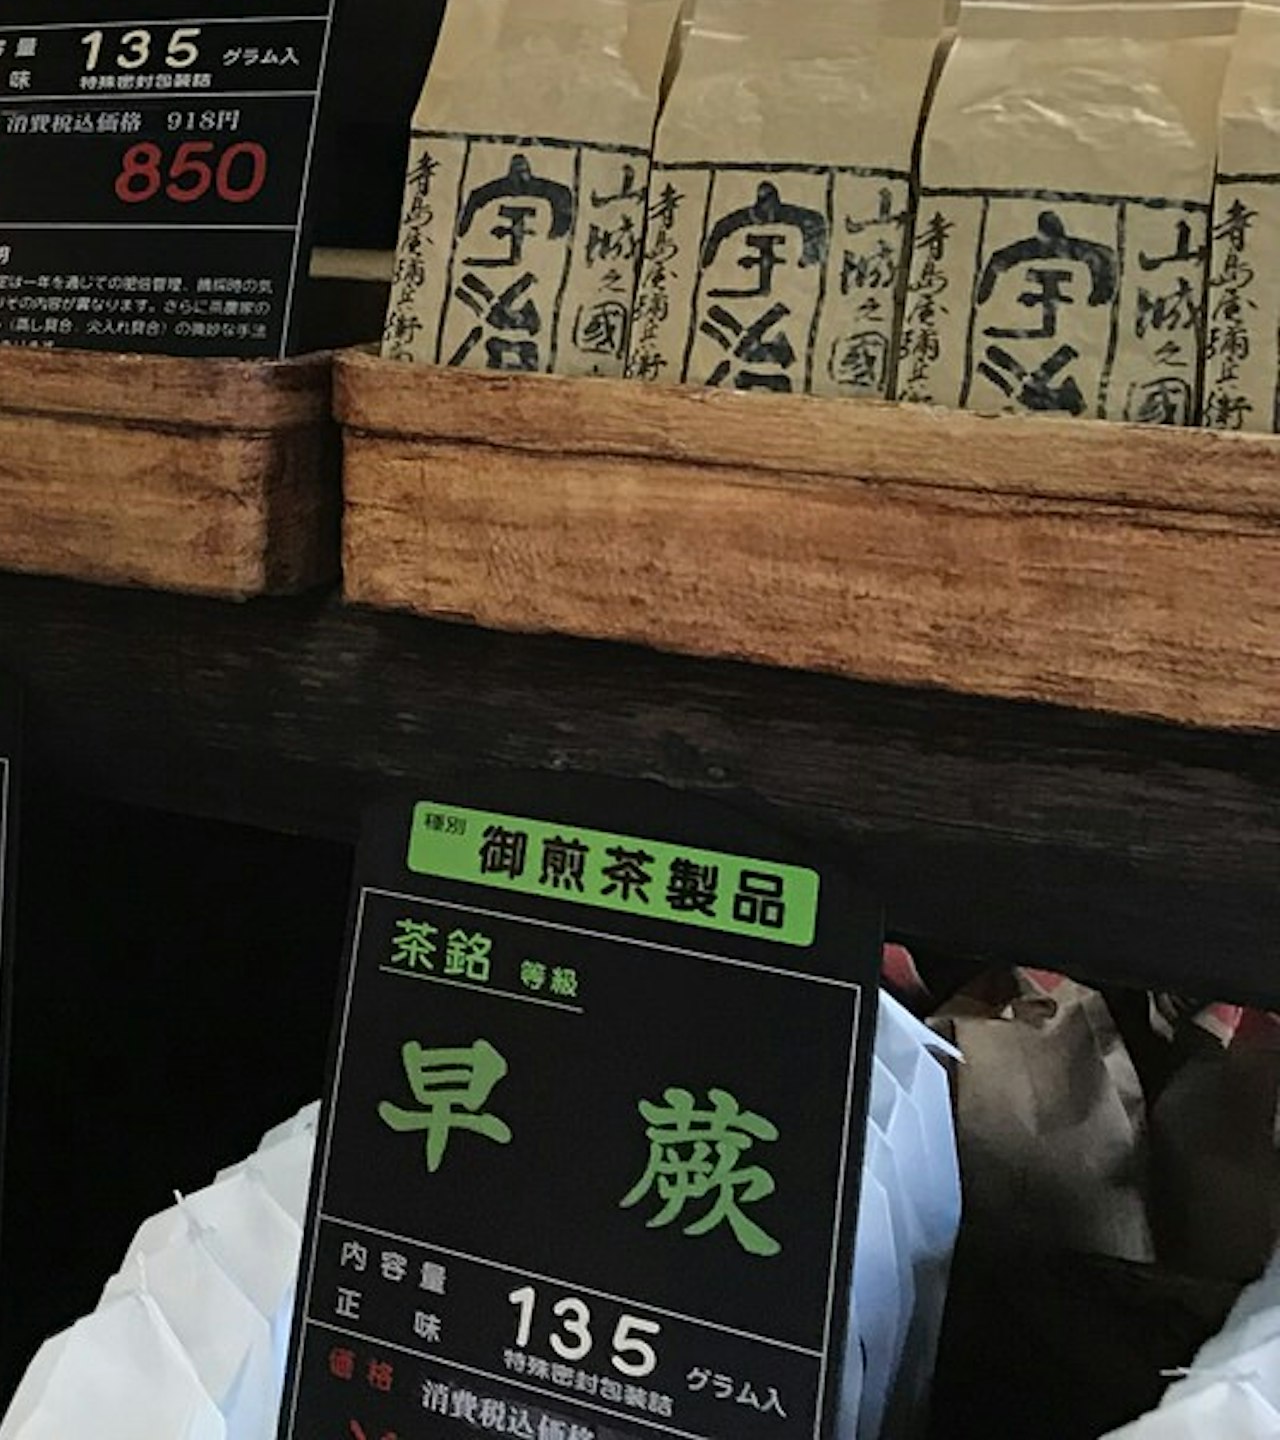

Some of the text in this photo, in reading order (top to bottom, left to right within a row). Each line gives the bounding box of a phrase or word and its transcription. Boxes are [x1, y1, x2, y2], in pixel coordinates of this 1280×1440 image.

[80, 27, 201, 70] 135
[222, 46, 300, 66] グラム入
[6, 111, 142, 135] 消費税込価格
[167, 109, 240, 132] 918円
[114, 142, 268, 204] 850
[423, 812, 788, 930] 種別 御煎茶製品
[389, 918, 580, 998] 茶銘 等級
[376, 1038, 784, 1258] 早蕨
[328, 1346, 394, 1393] 価格
[333, 1286, 675, 1417] 正味 特殊密封包装詰
[340, 1240, 788, 1419] 内容量 135 グラム入
